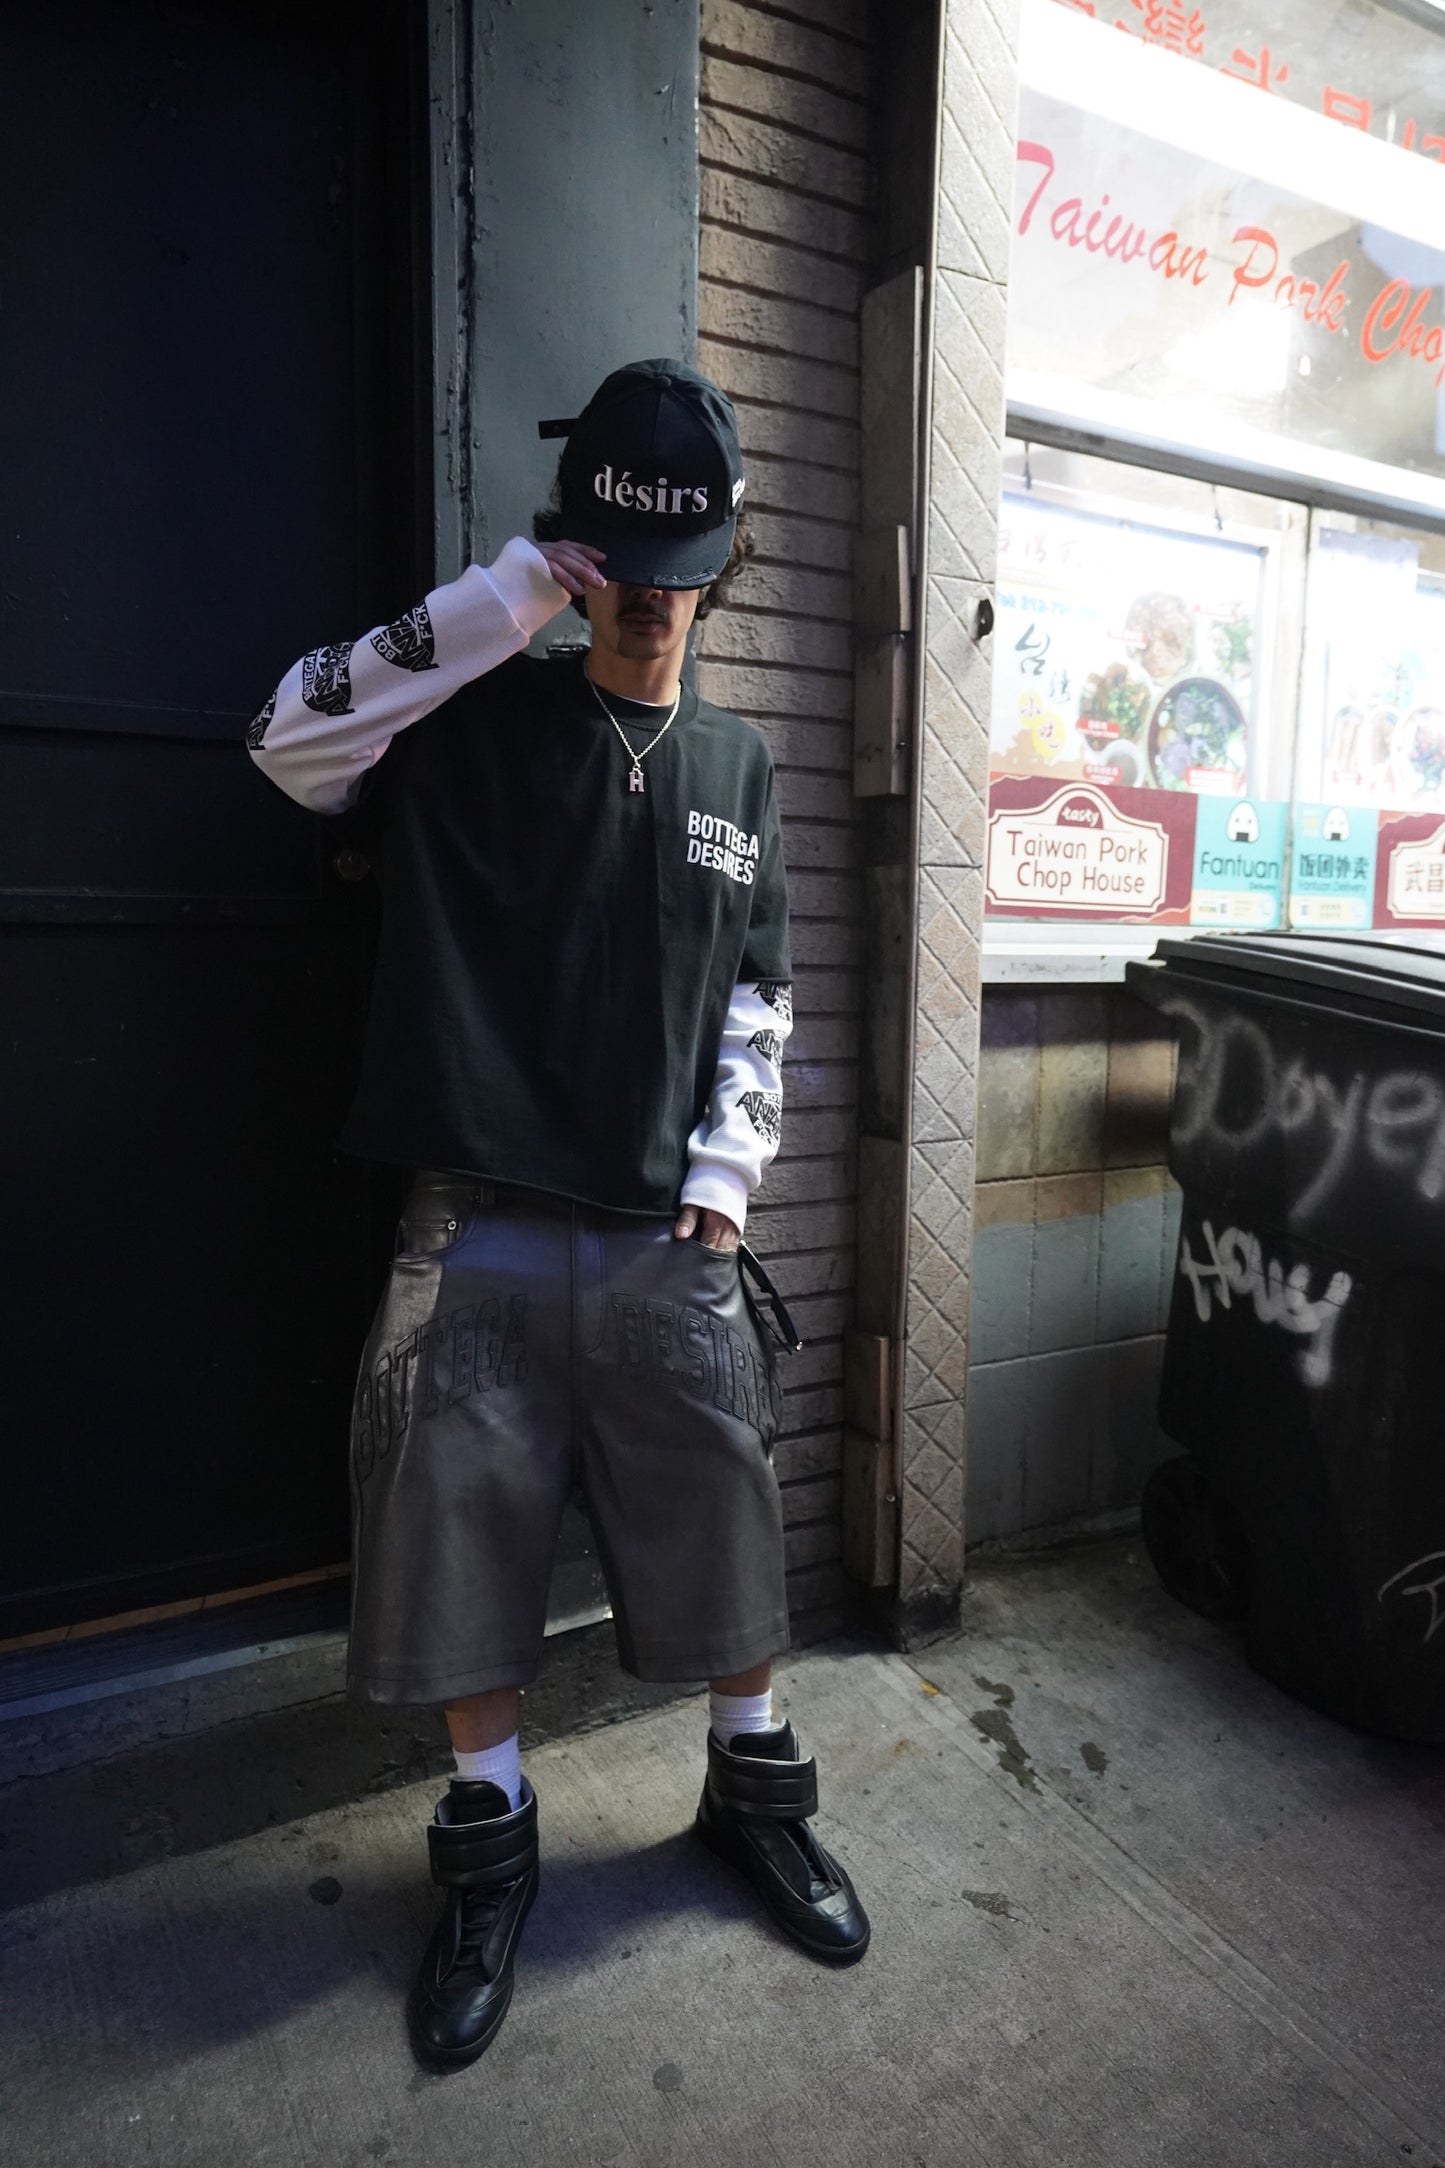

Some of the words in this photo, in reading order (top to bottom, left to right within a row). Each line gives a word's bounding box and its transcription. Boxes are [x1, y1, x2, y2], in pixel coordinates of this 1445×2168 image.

[1016, 140, 1211, 287] Taiwan
[1228, 225, 1350, 333] Pork
[594, 464, 709, 514] désirs
[687, 810, 760, 860] BOTTEGA
[1006, 829, 1087, 861] Taiwan
[1099, 836, 1148, 865] Pork
[686, 838, 755, 885] DESIRES
[1016, 860, 1072, 896] Chop
[1082, 865, 1146, 894] House
[1200, 851, 1279, 882] Fantuan
[353, 1293, 530, 1484] BOTTEGA
[611, 1292, 783, 1450] DESIRE
